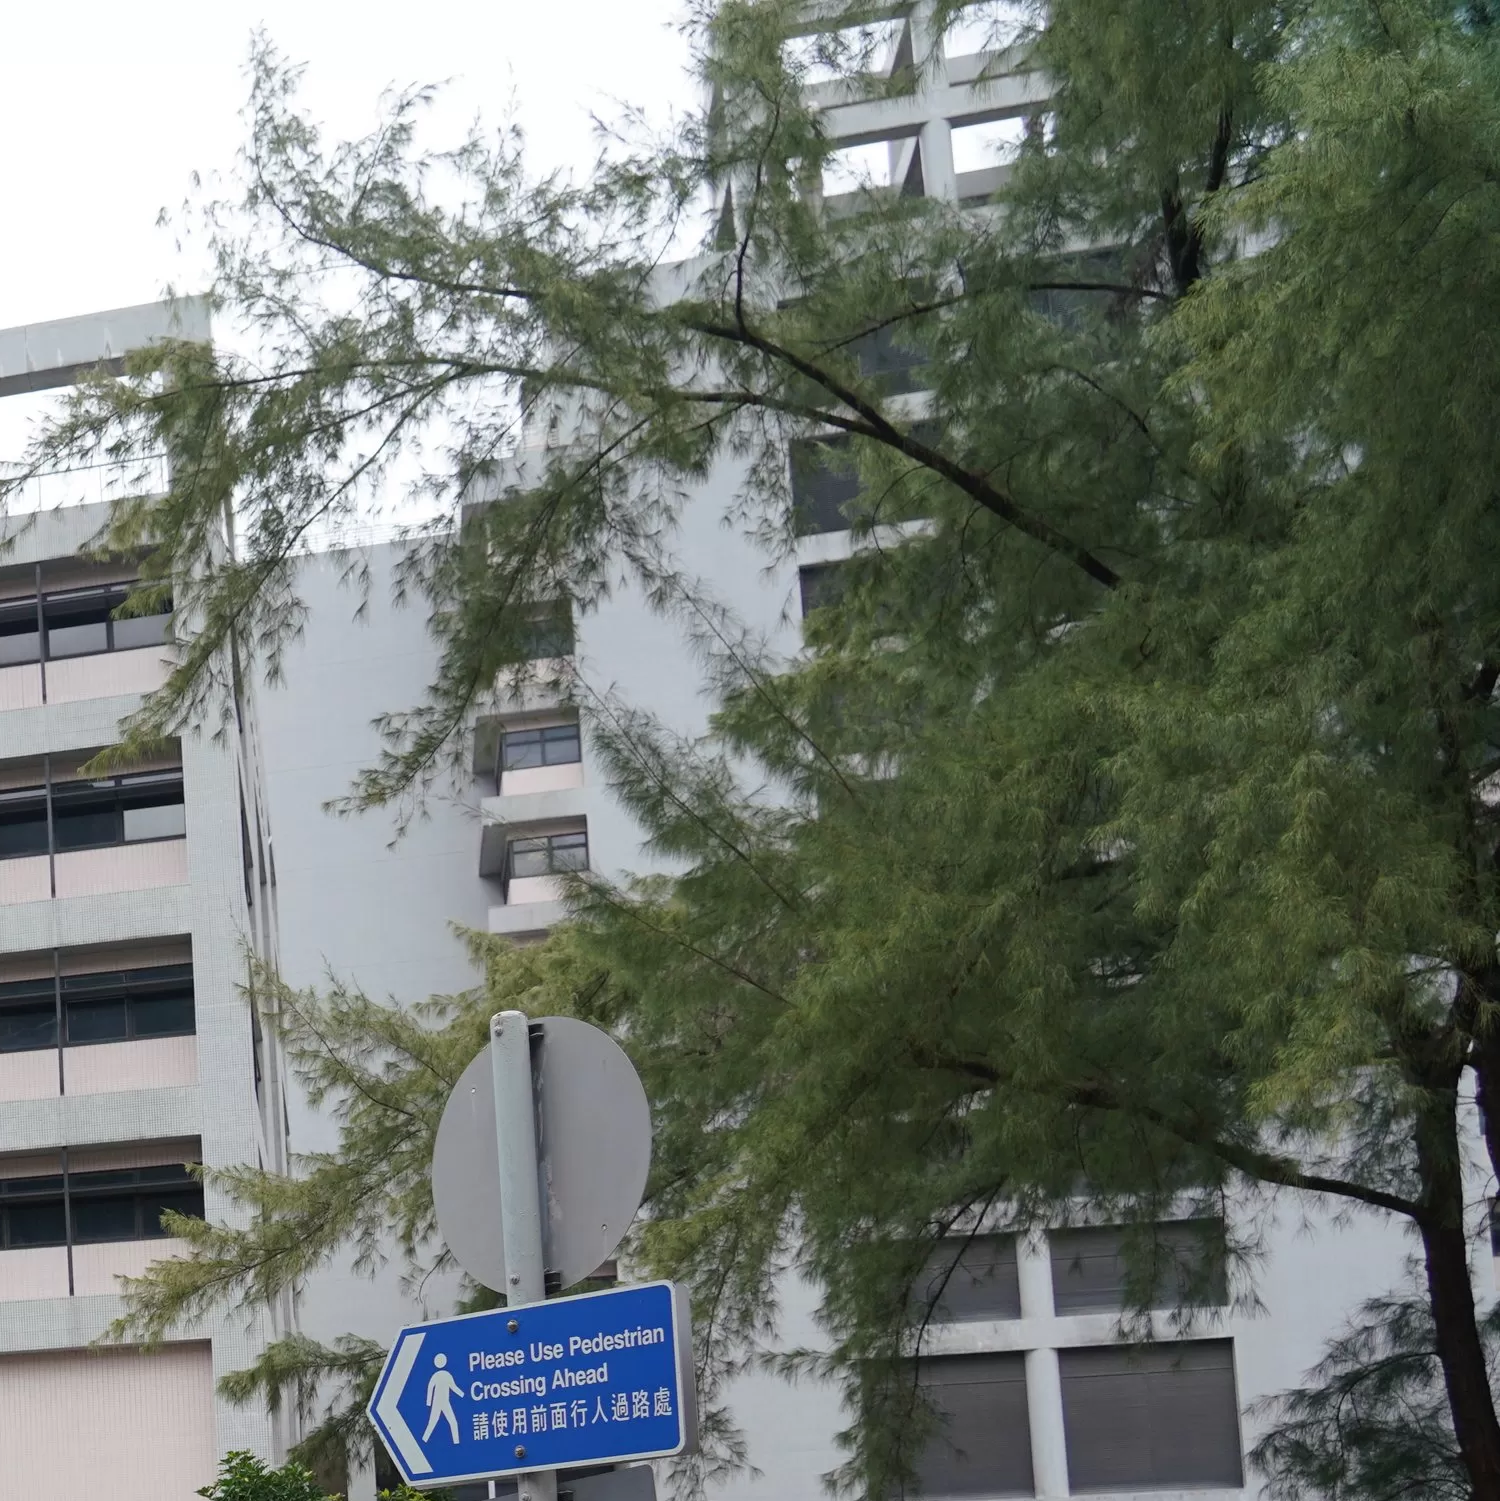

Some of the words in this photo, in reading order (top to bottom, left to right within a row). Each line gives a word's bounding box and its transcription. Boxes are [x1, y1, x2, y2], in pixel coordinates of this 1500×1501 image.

[469, 1349, 525, 1372] Please
[530, 1341, 564, 1363] Use
[569, 1326, 665, 1357] Pedestrian
[470, 1375, 546, 1401] Crossing
[552, 1362, 609, 1390] Ahead
[472, 1386, 673, 1441] 請使用前面行人過路處
